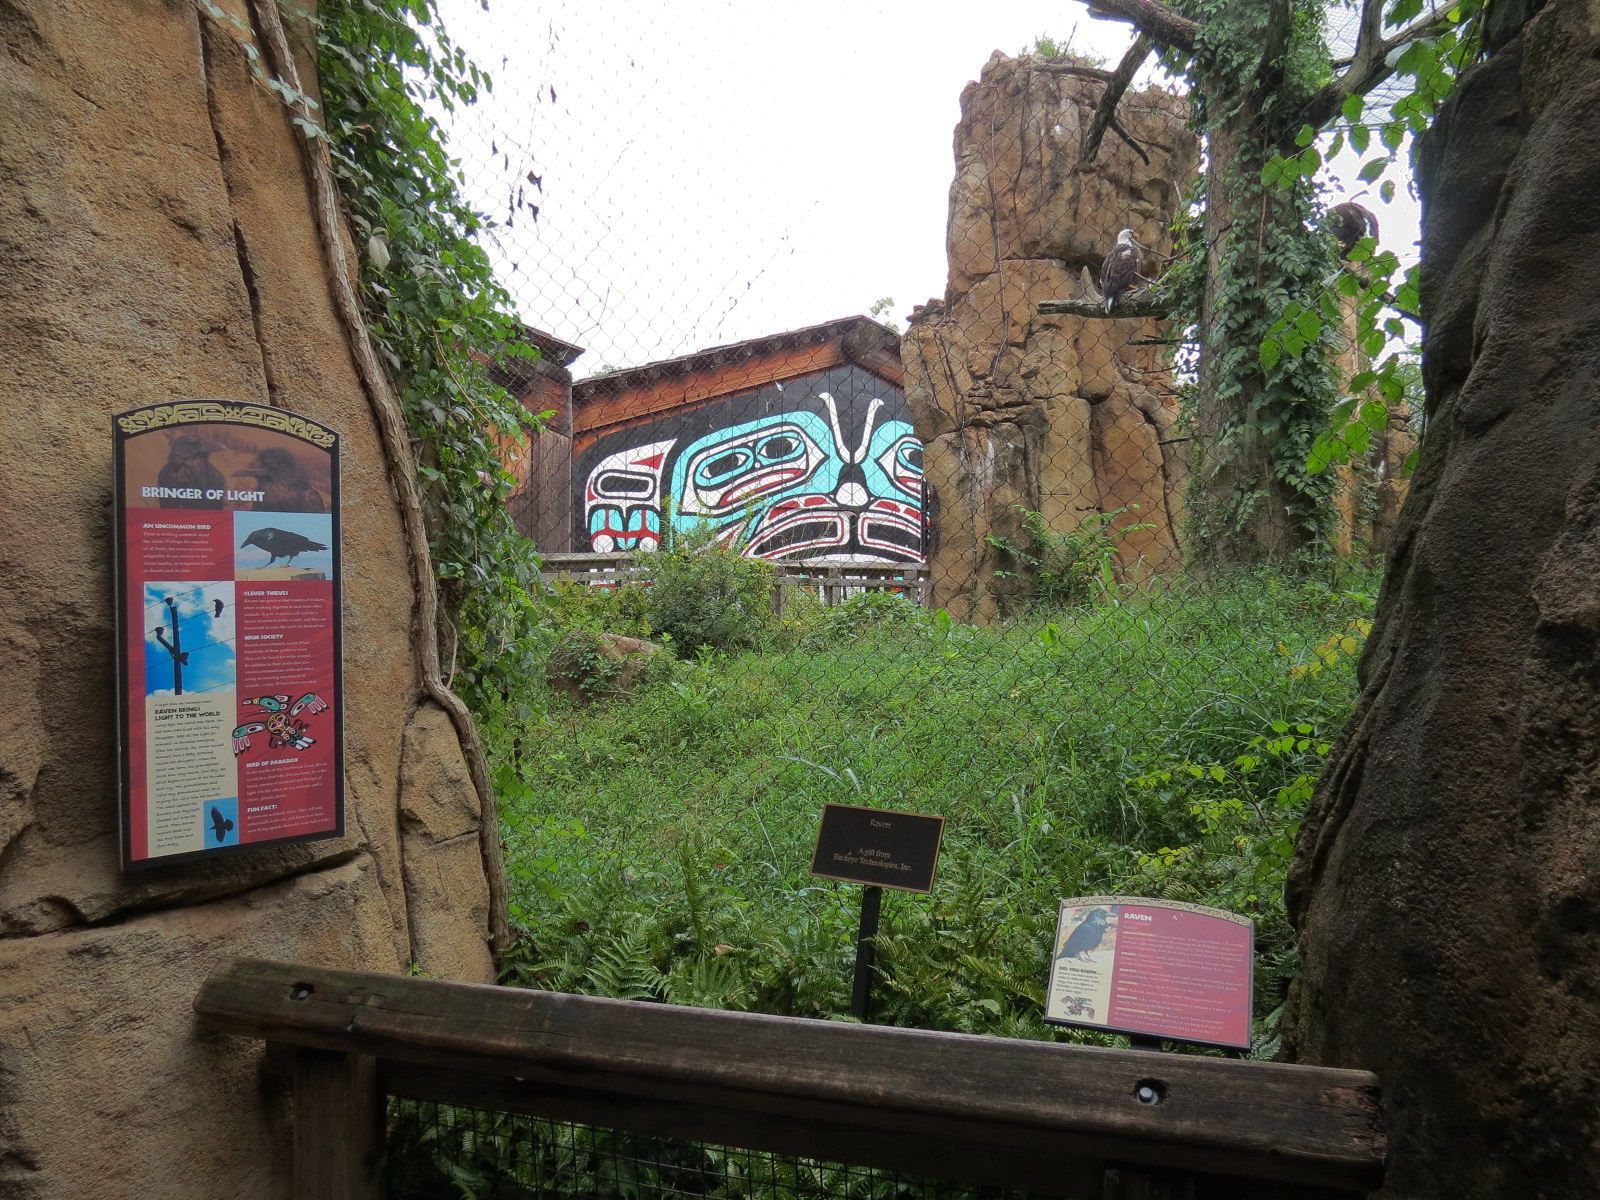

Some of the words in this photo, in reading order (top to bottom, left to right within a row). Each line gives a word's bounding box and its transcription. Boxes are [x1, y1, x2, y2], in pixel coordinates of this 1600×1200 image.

[142, 486, 203, 500] BRINGER
[206, 489, 224, 501] OF
[227, 490, 265, 502] LIGHT
[271, 757, 299, 765] PARADOX
[870, 818, 891, 829] Raven
[864, 848, 875, 857] gift
[876, 849, 891, 859] from
[901, 863, 912, 872] Inc.
[1124, 912, 1152, 921] RAVEN
